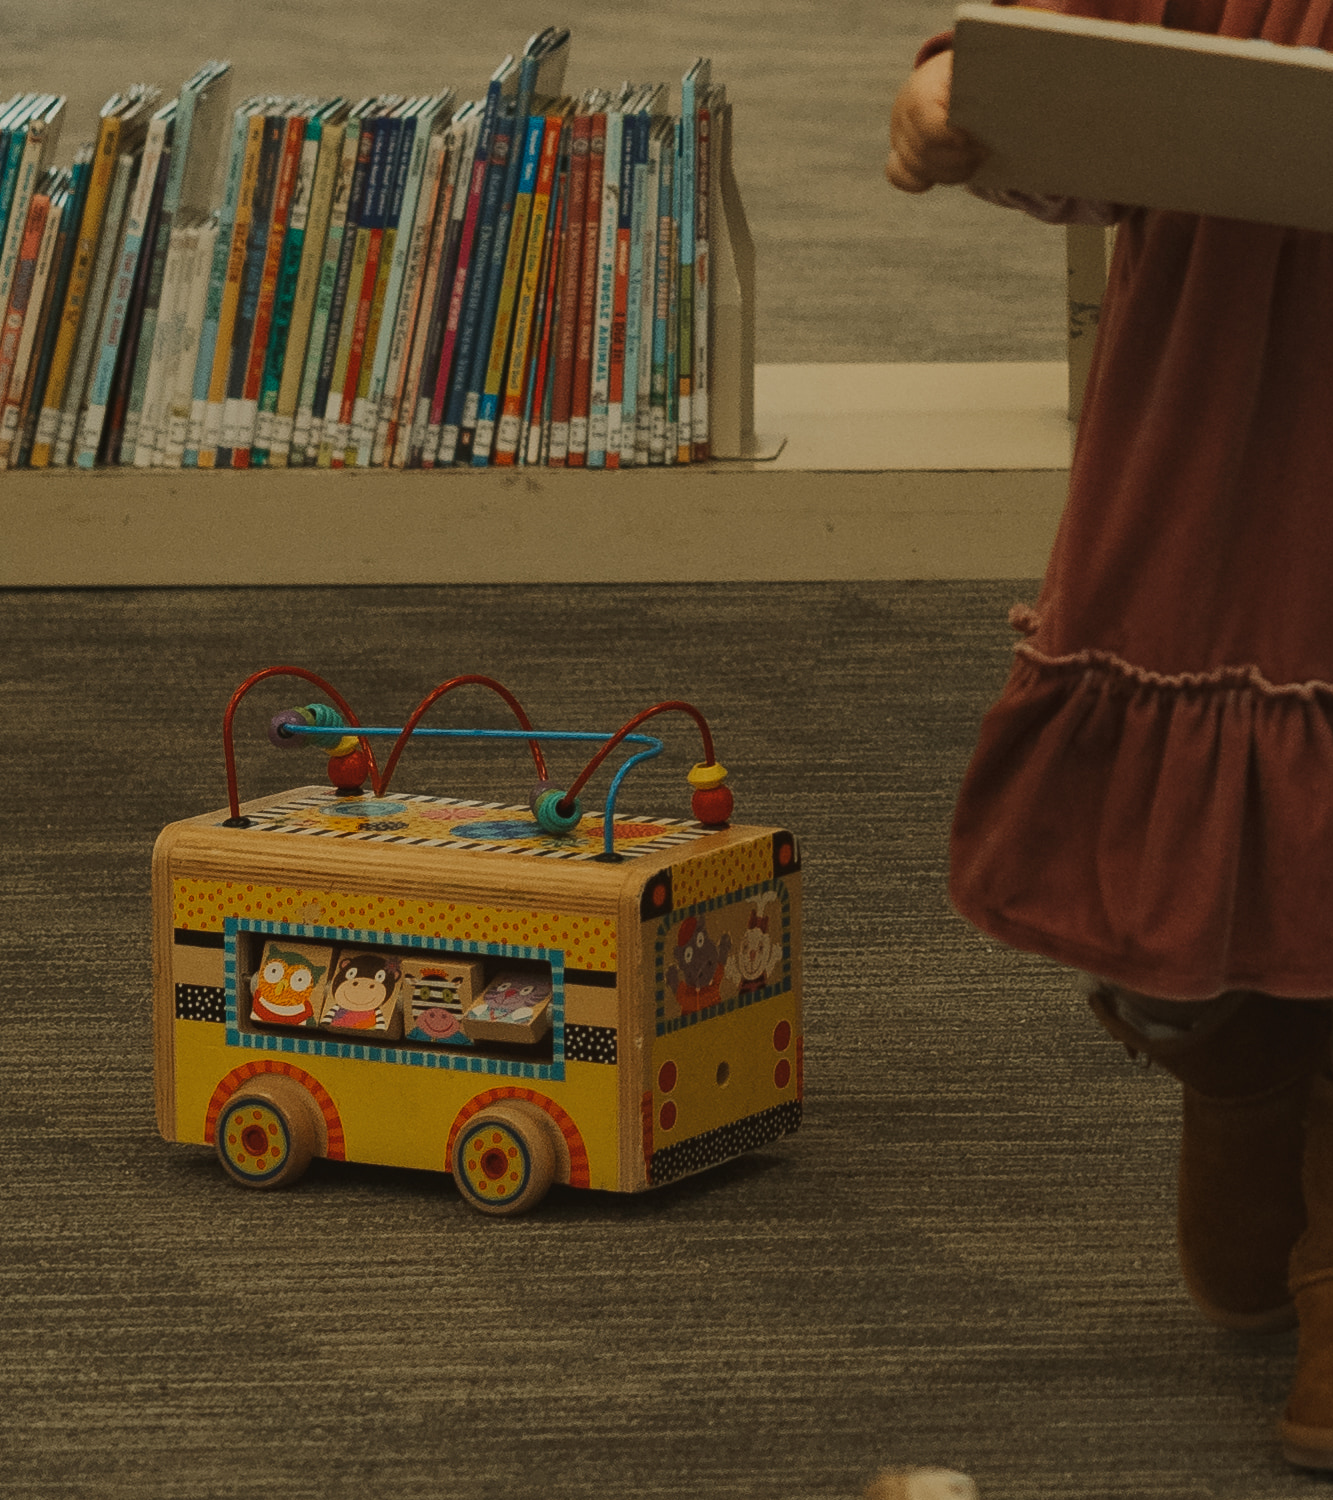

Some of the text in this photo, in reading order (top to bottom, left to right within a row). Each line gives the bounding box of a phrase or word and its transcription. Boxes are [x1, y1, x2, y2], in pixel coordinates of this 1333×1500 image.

[597, 263, 612, 382] JUNGLE ANIMAL
[613, 323, 624, 344] Did
[612, 349, 623, 364] It!
